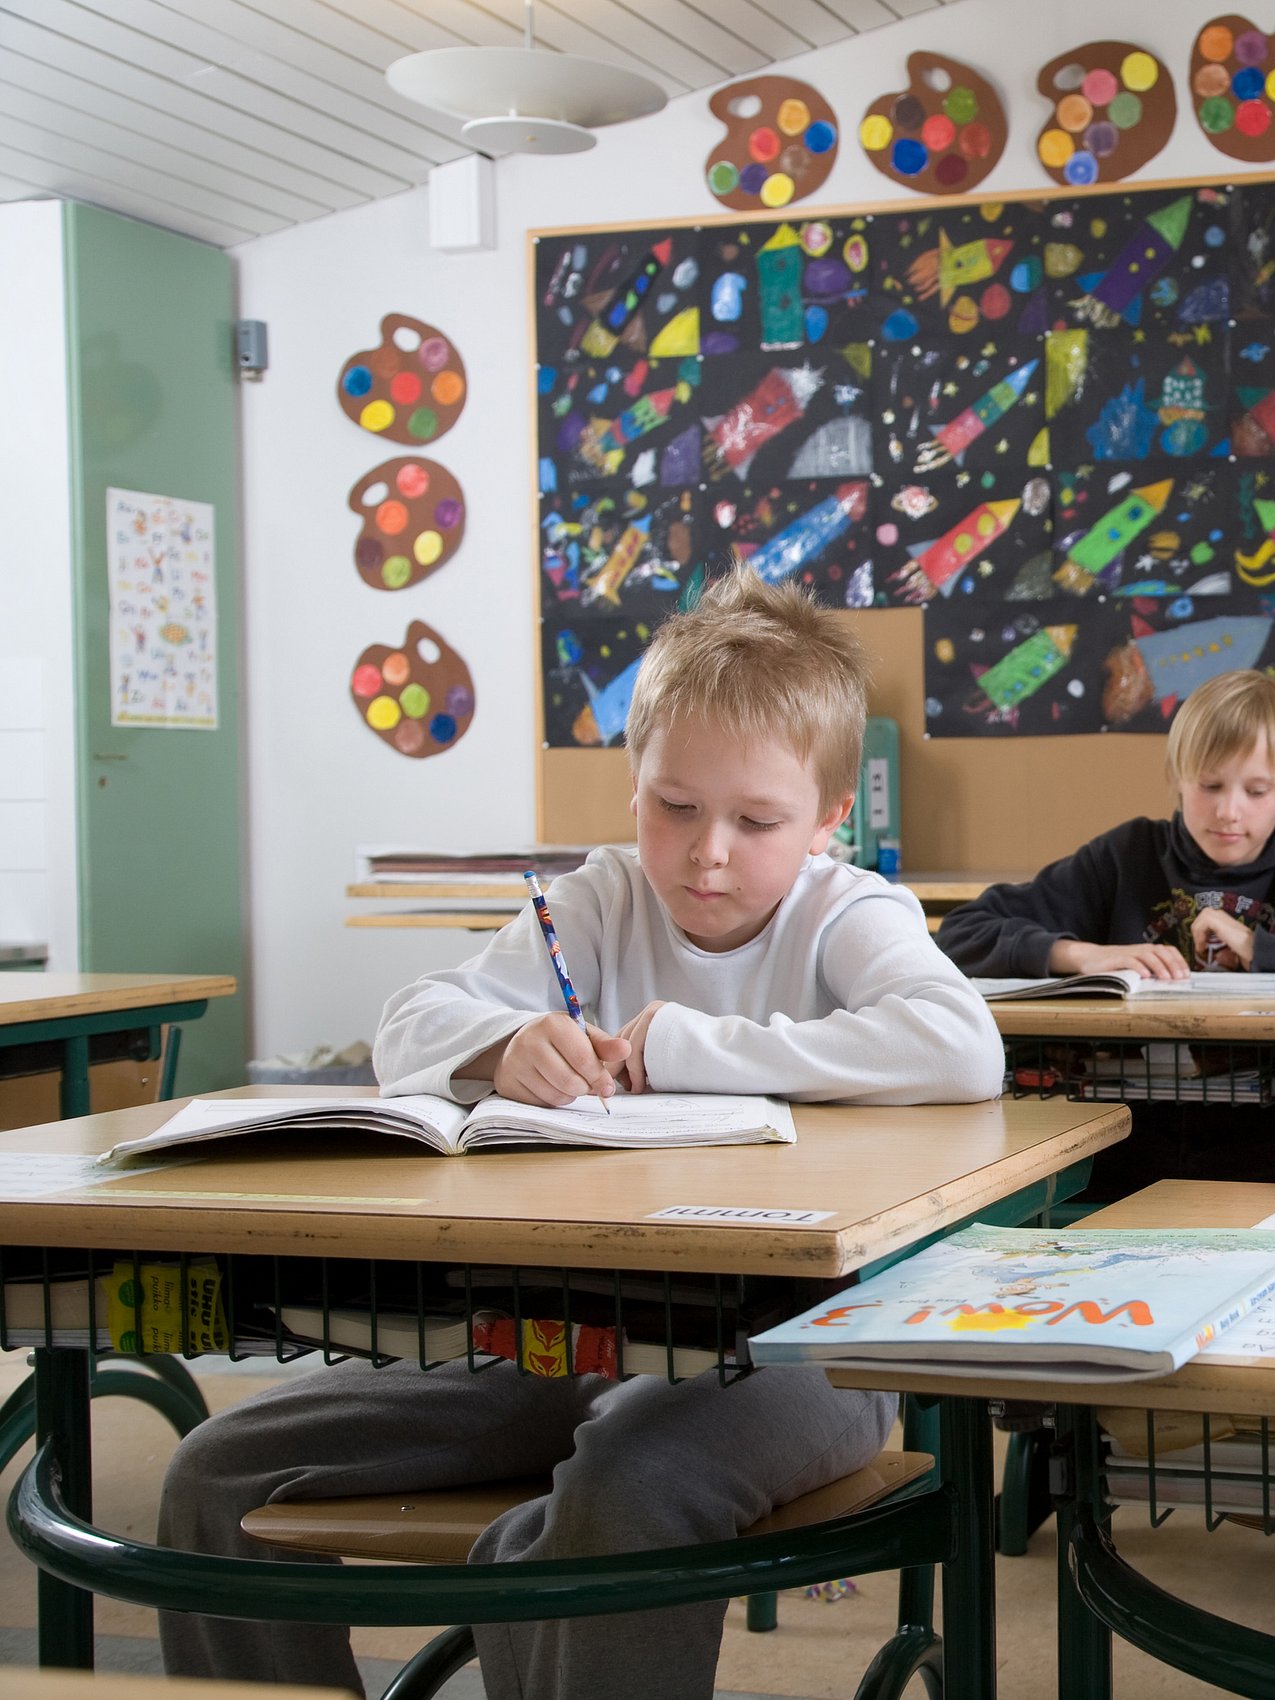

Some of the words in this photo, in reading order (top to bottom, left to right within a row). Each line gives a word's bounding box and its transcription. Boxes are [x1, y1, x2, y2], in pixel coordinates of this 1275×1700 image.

[659, 1207, 814, 1222] Tommi
[151, 1275, 162, 1311] puikko
[202, 1278, 216, 1327] UHU
[811, 1303, 882, 1326] 3
[903, 1300, 1152, 1326] Wow!
[151, 1327, 162, 1352] puik
[163, 1331, 174, 1352] liim
